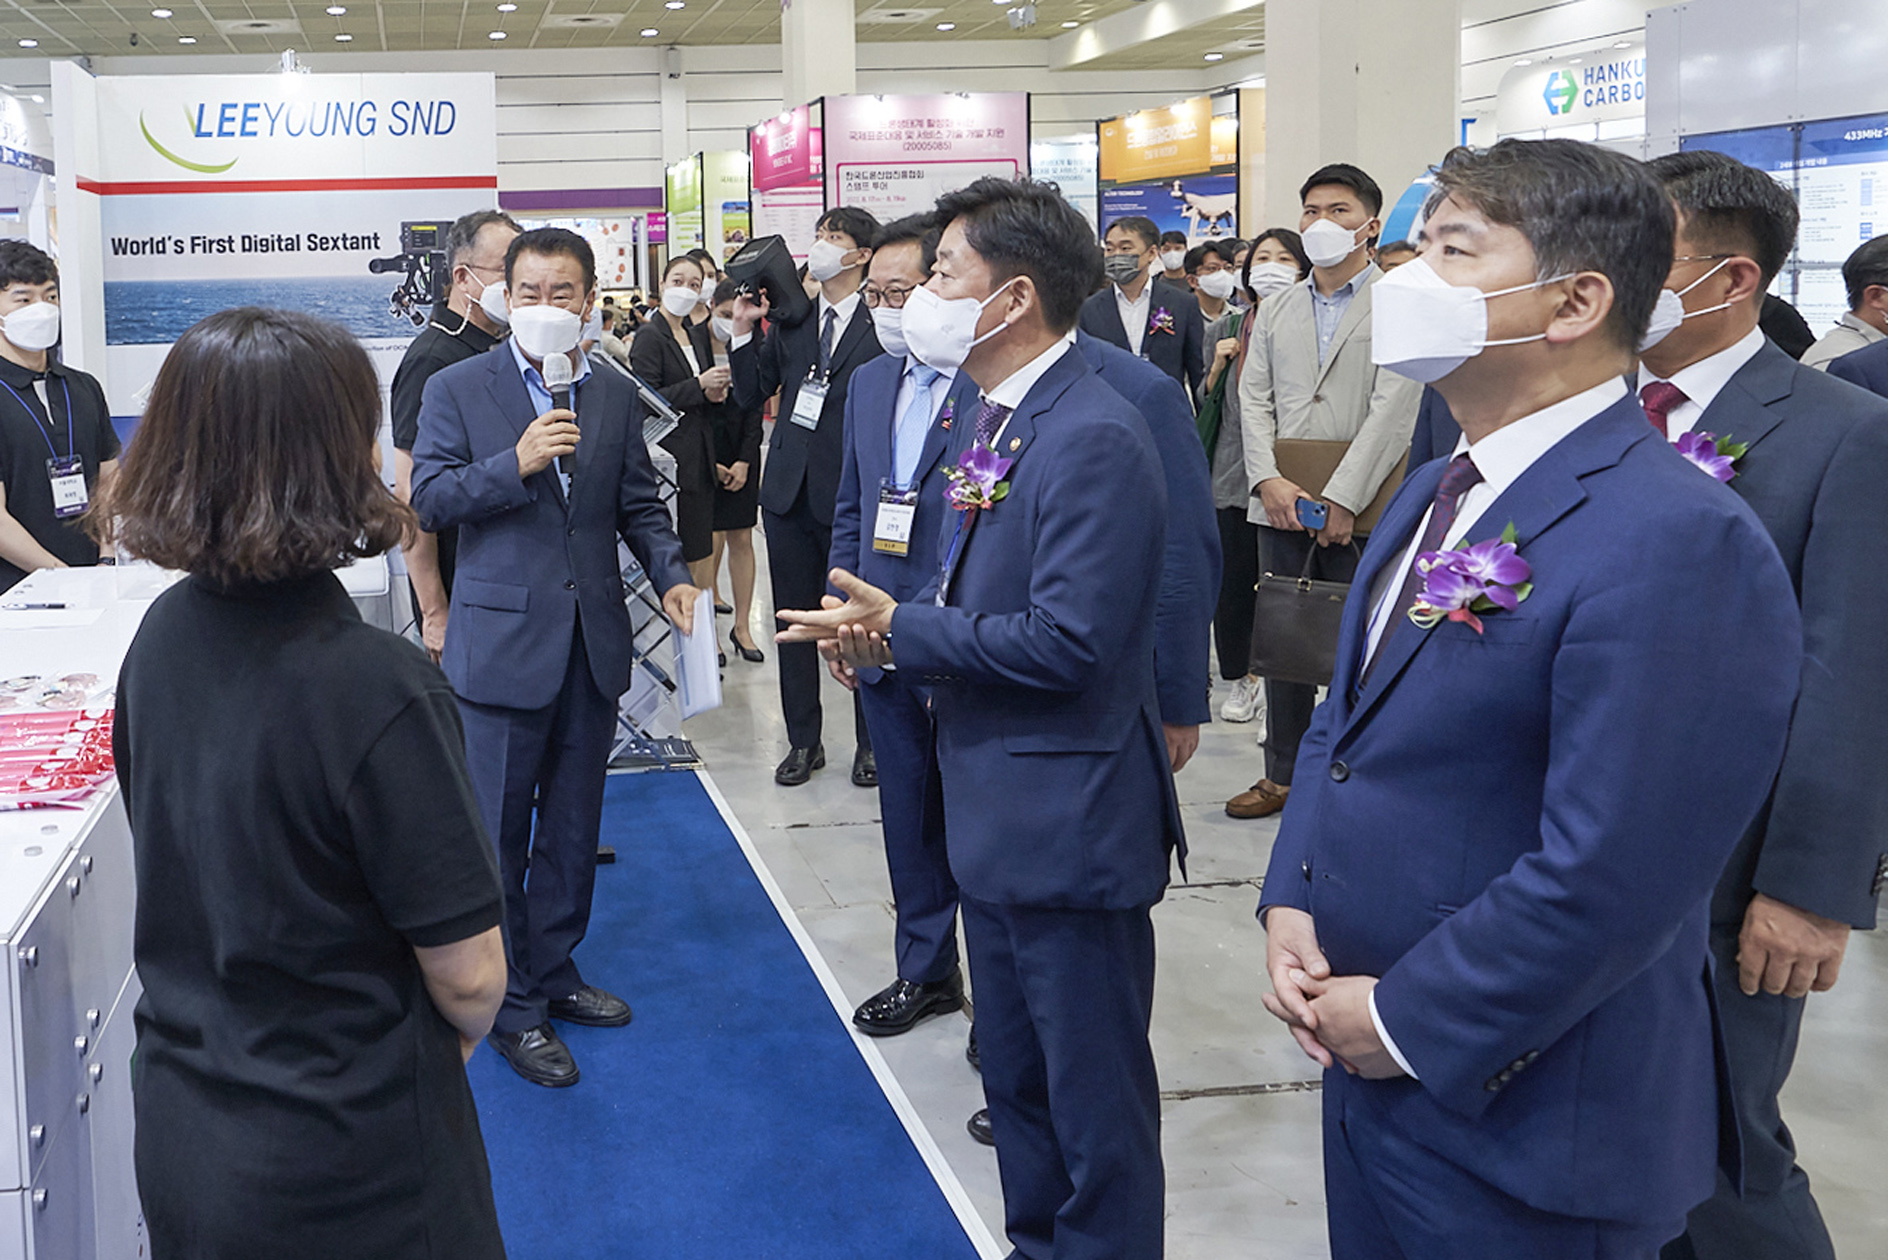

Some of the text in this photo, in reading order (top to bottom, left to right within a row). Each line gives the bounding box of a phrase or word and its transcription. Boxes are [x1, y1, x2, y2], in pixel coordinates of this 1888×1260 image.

[194, 100, 456, 138] LEEYOUNG SND
[916, 130, 944, 140] 서비스
[1844, 129, 1883, 140] 433MHz
[902, 141, 952, 151] (20005085)
[111, 232, 381, 256] World's First Digital Sextant
